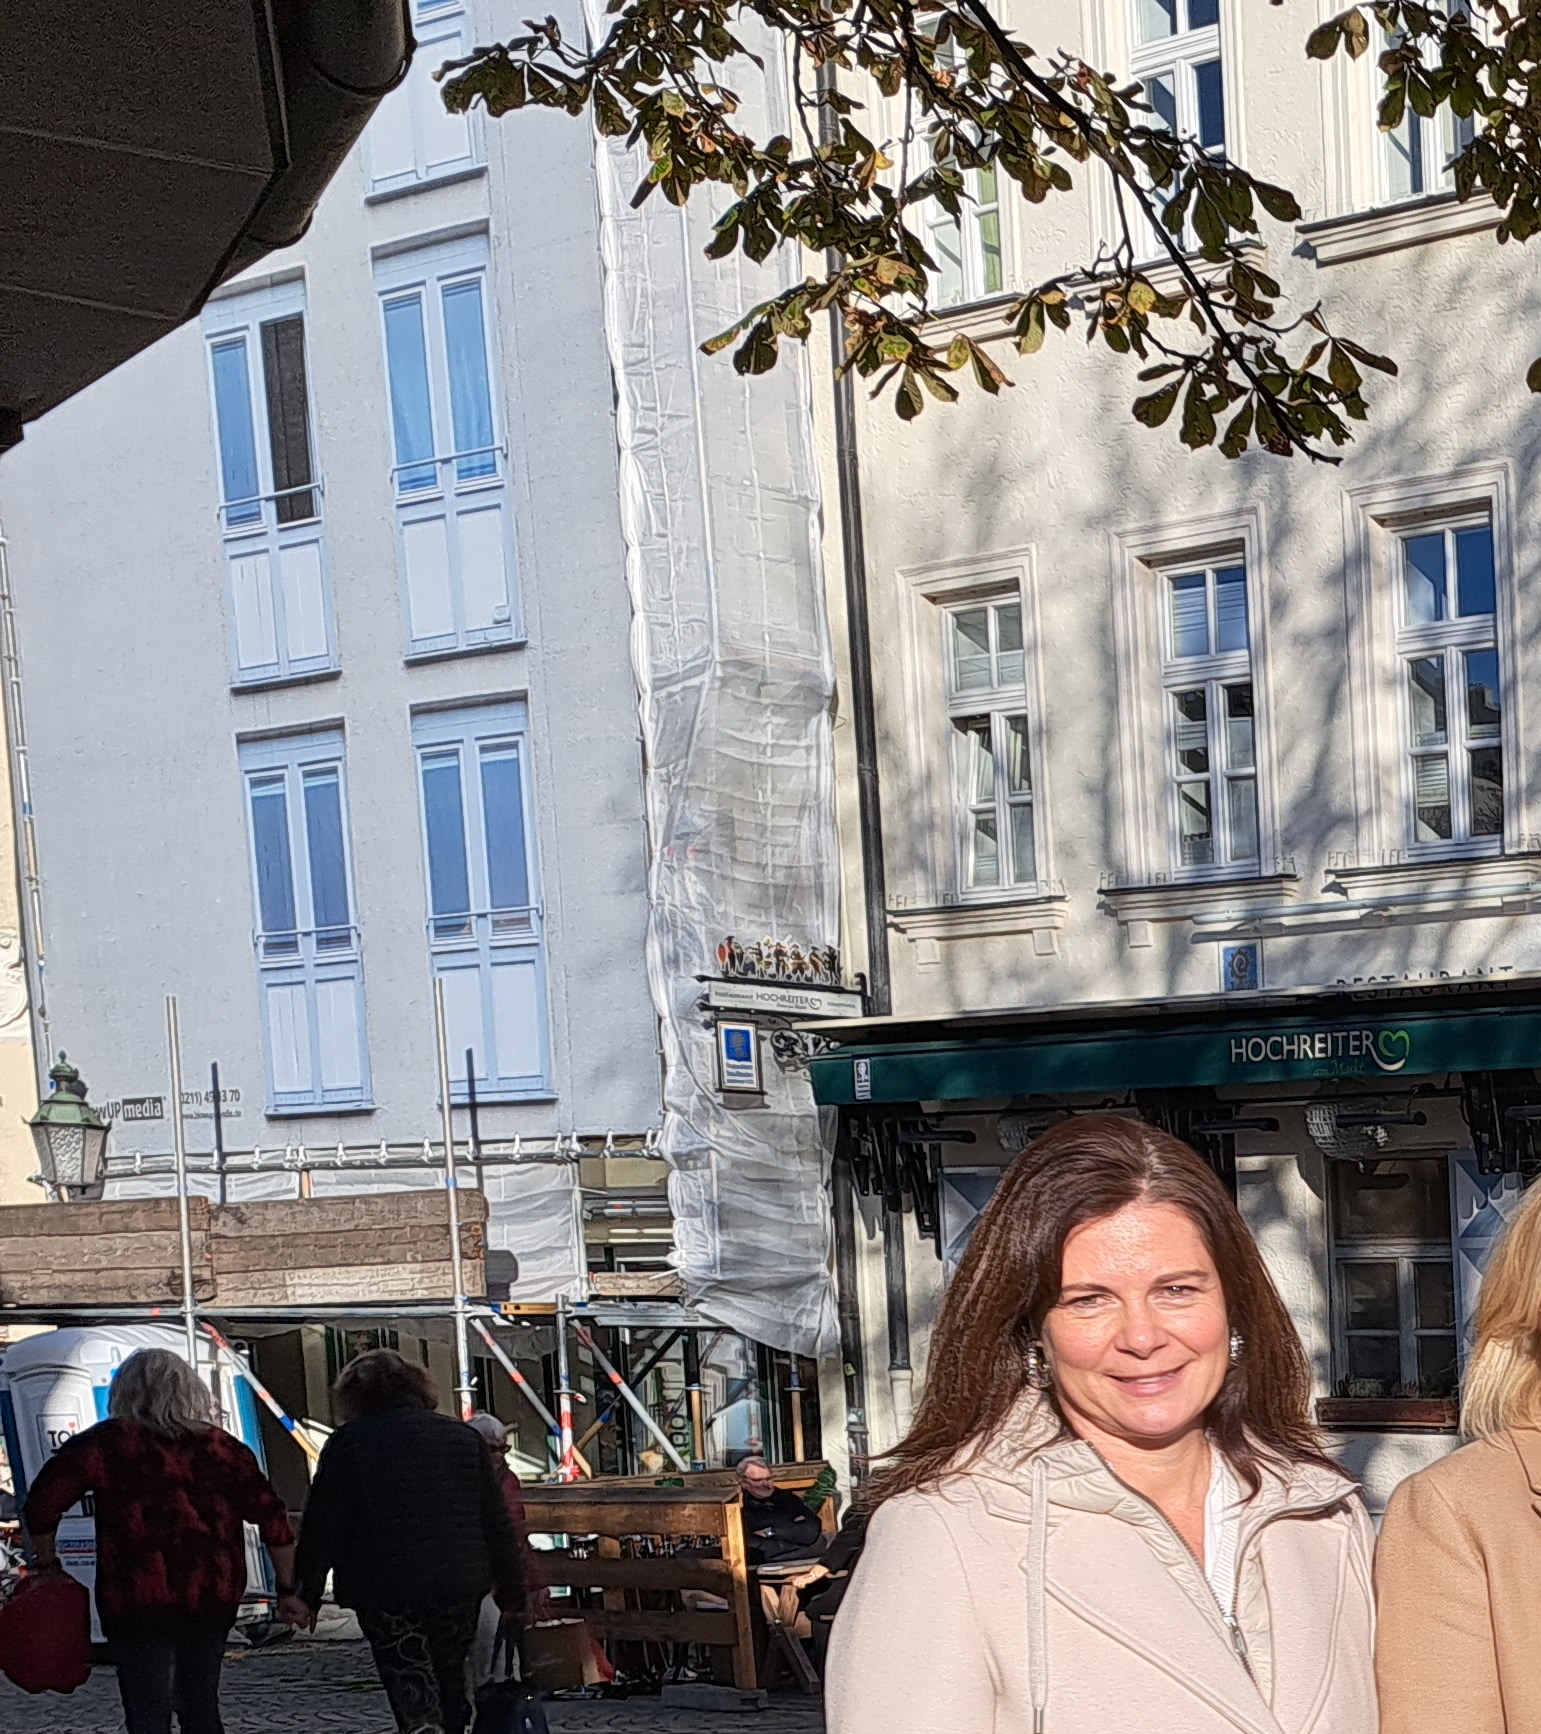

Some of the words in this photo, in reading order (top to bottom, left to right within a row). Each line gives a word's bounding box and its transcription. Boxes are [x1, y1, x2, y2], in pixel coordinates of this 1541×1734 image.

[756, 992, 808, 1005] HOCHREITER
[1230, 1030, 1378, 1064] HOCHREITER
[124, 1098, 162, 1118] media
[47, 1430, 76, 1447] TO
